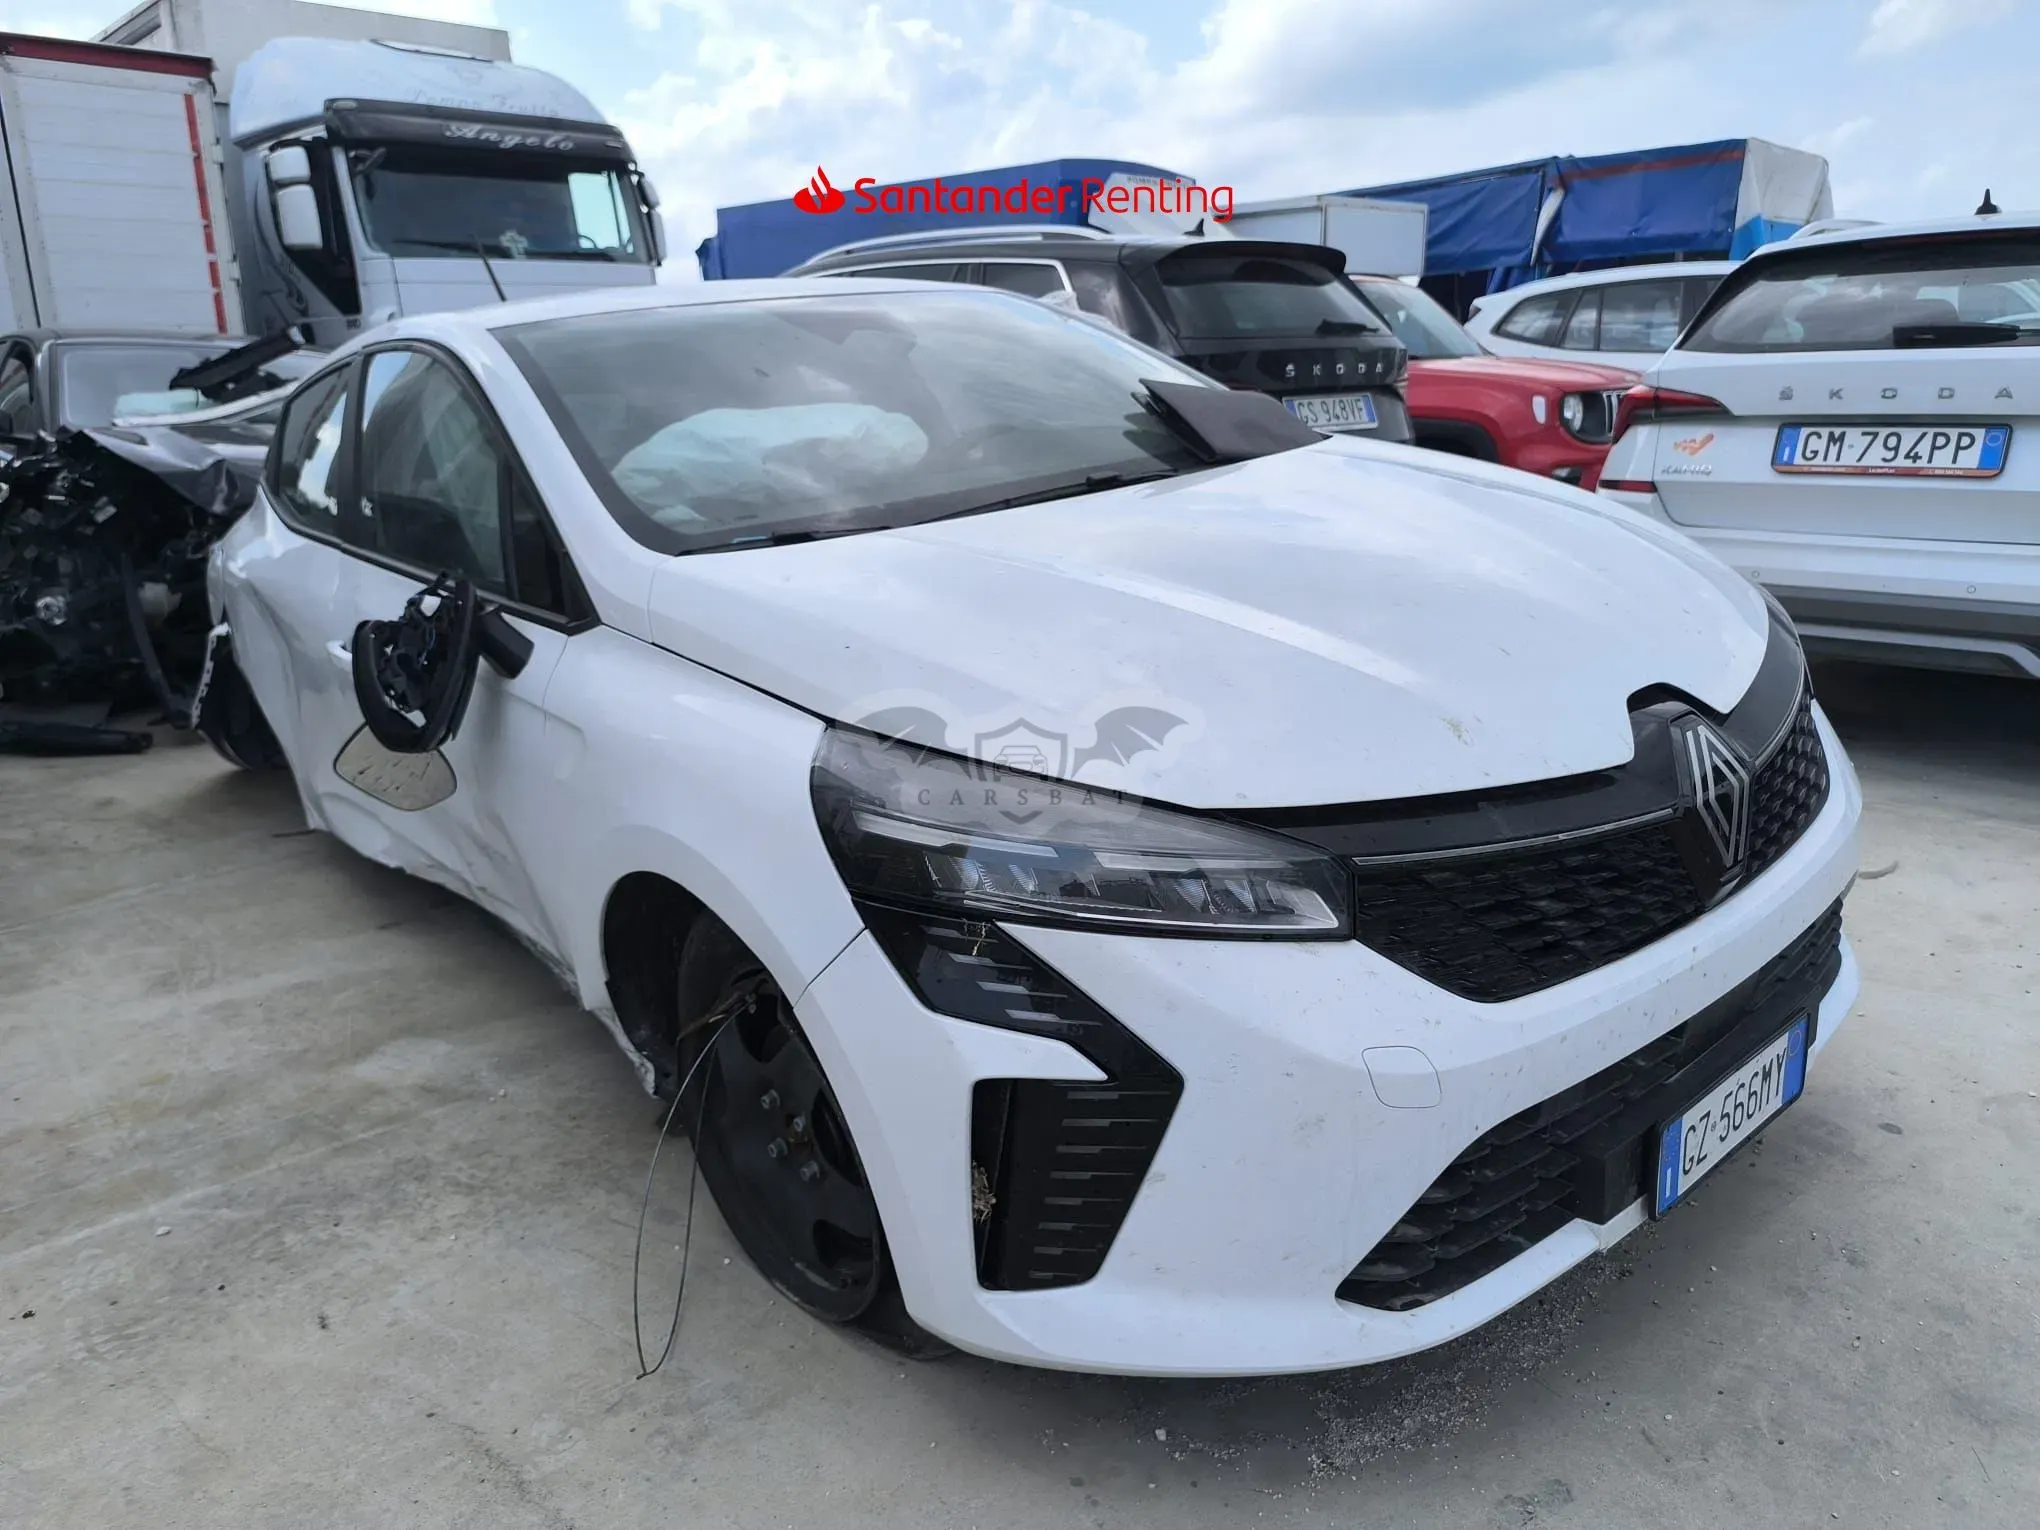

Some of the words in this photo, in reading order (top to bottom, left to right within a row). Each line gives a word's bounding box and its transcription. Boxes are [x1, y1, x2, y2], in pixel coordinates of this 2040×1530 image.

[444, 122, 575, 151] Angelo
[1320, 397, 1364, 423] 948VF
[1800, 431, 1847, 463] GM
[1855, 431, 1976, 465] 794PP
[1682, 1109, 1712, 1177] GZ
[1719, 1047, 1787, 1143] 566MY
